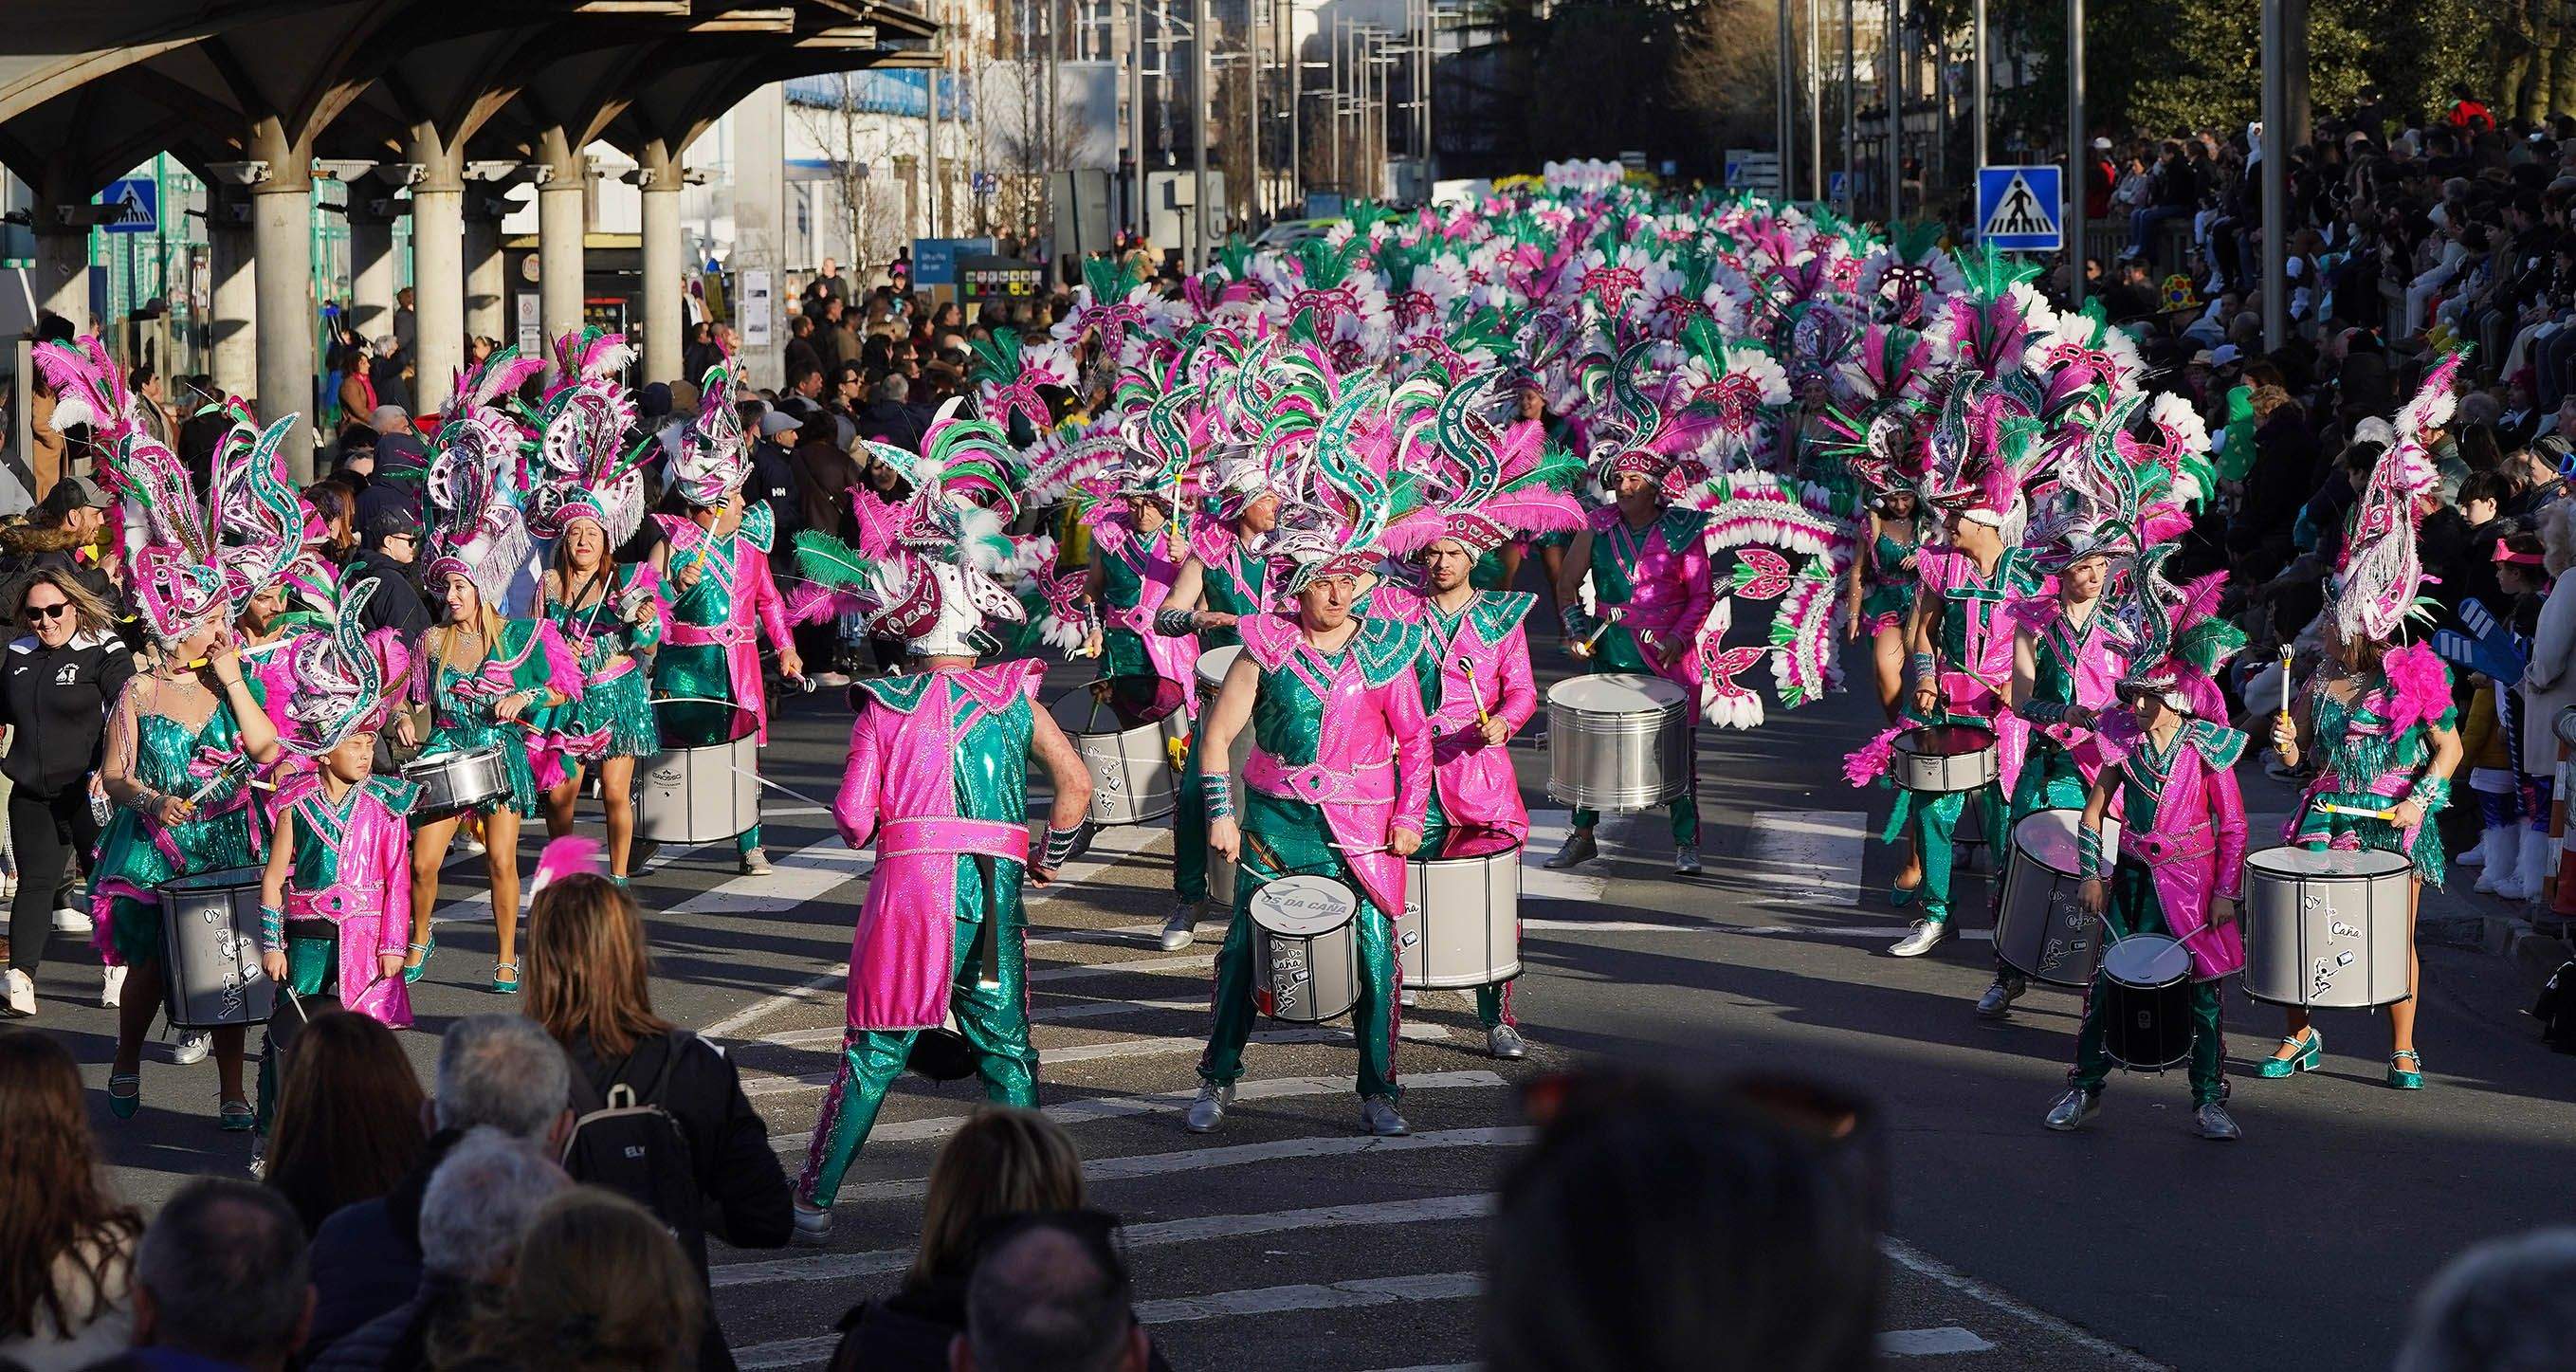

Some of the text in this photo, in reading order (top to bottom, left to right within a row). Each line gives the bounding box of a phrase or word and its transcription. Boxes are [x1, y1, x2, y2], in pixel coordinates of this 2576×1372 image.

[1261, 896, 1347, 913] OS DA CAÑA
[203, 908, 221, 924] Os
[2332, 921, 2362, 939] Caña
[1288, 949, 1303, 958] Da
[1270, 957, 1303, 969] Caña
